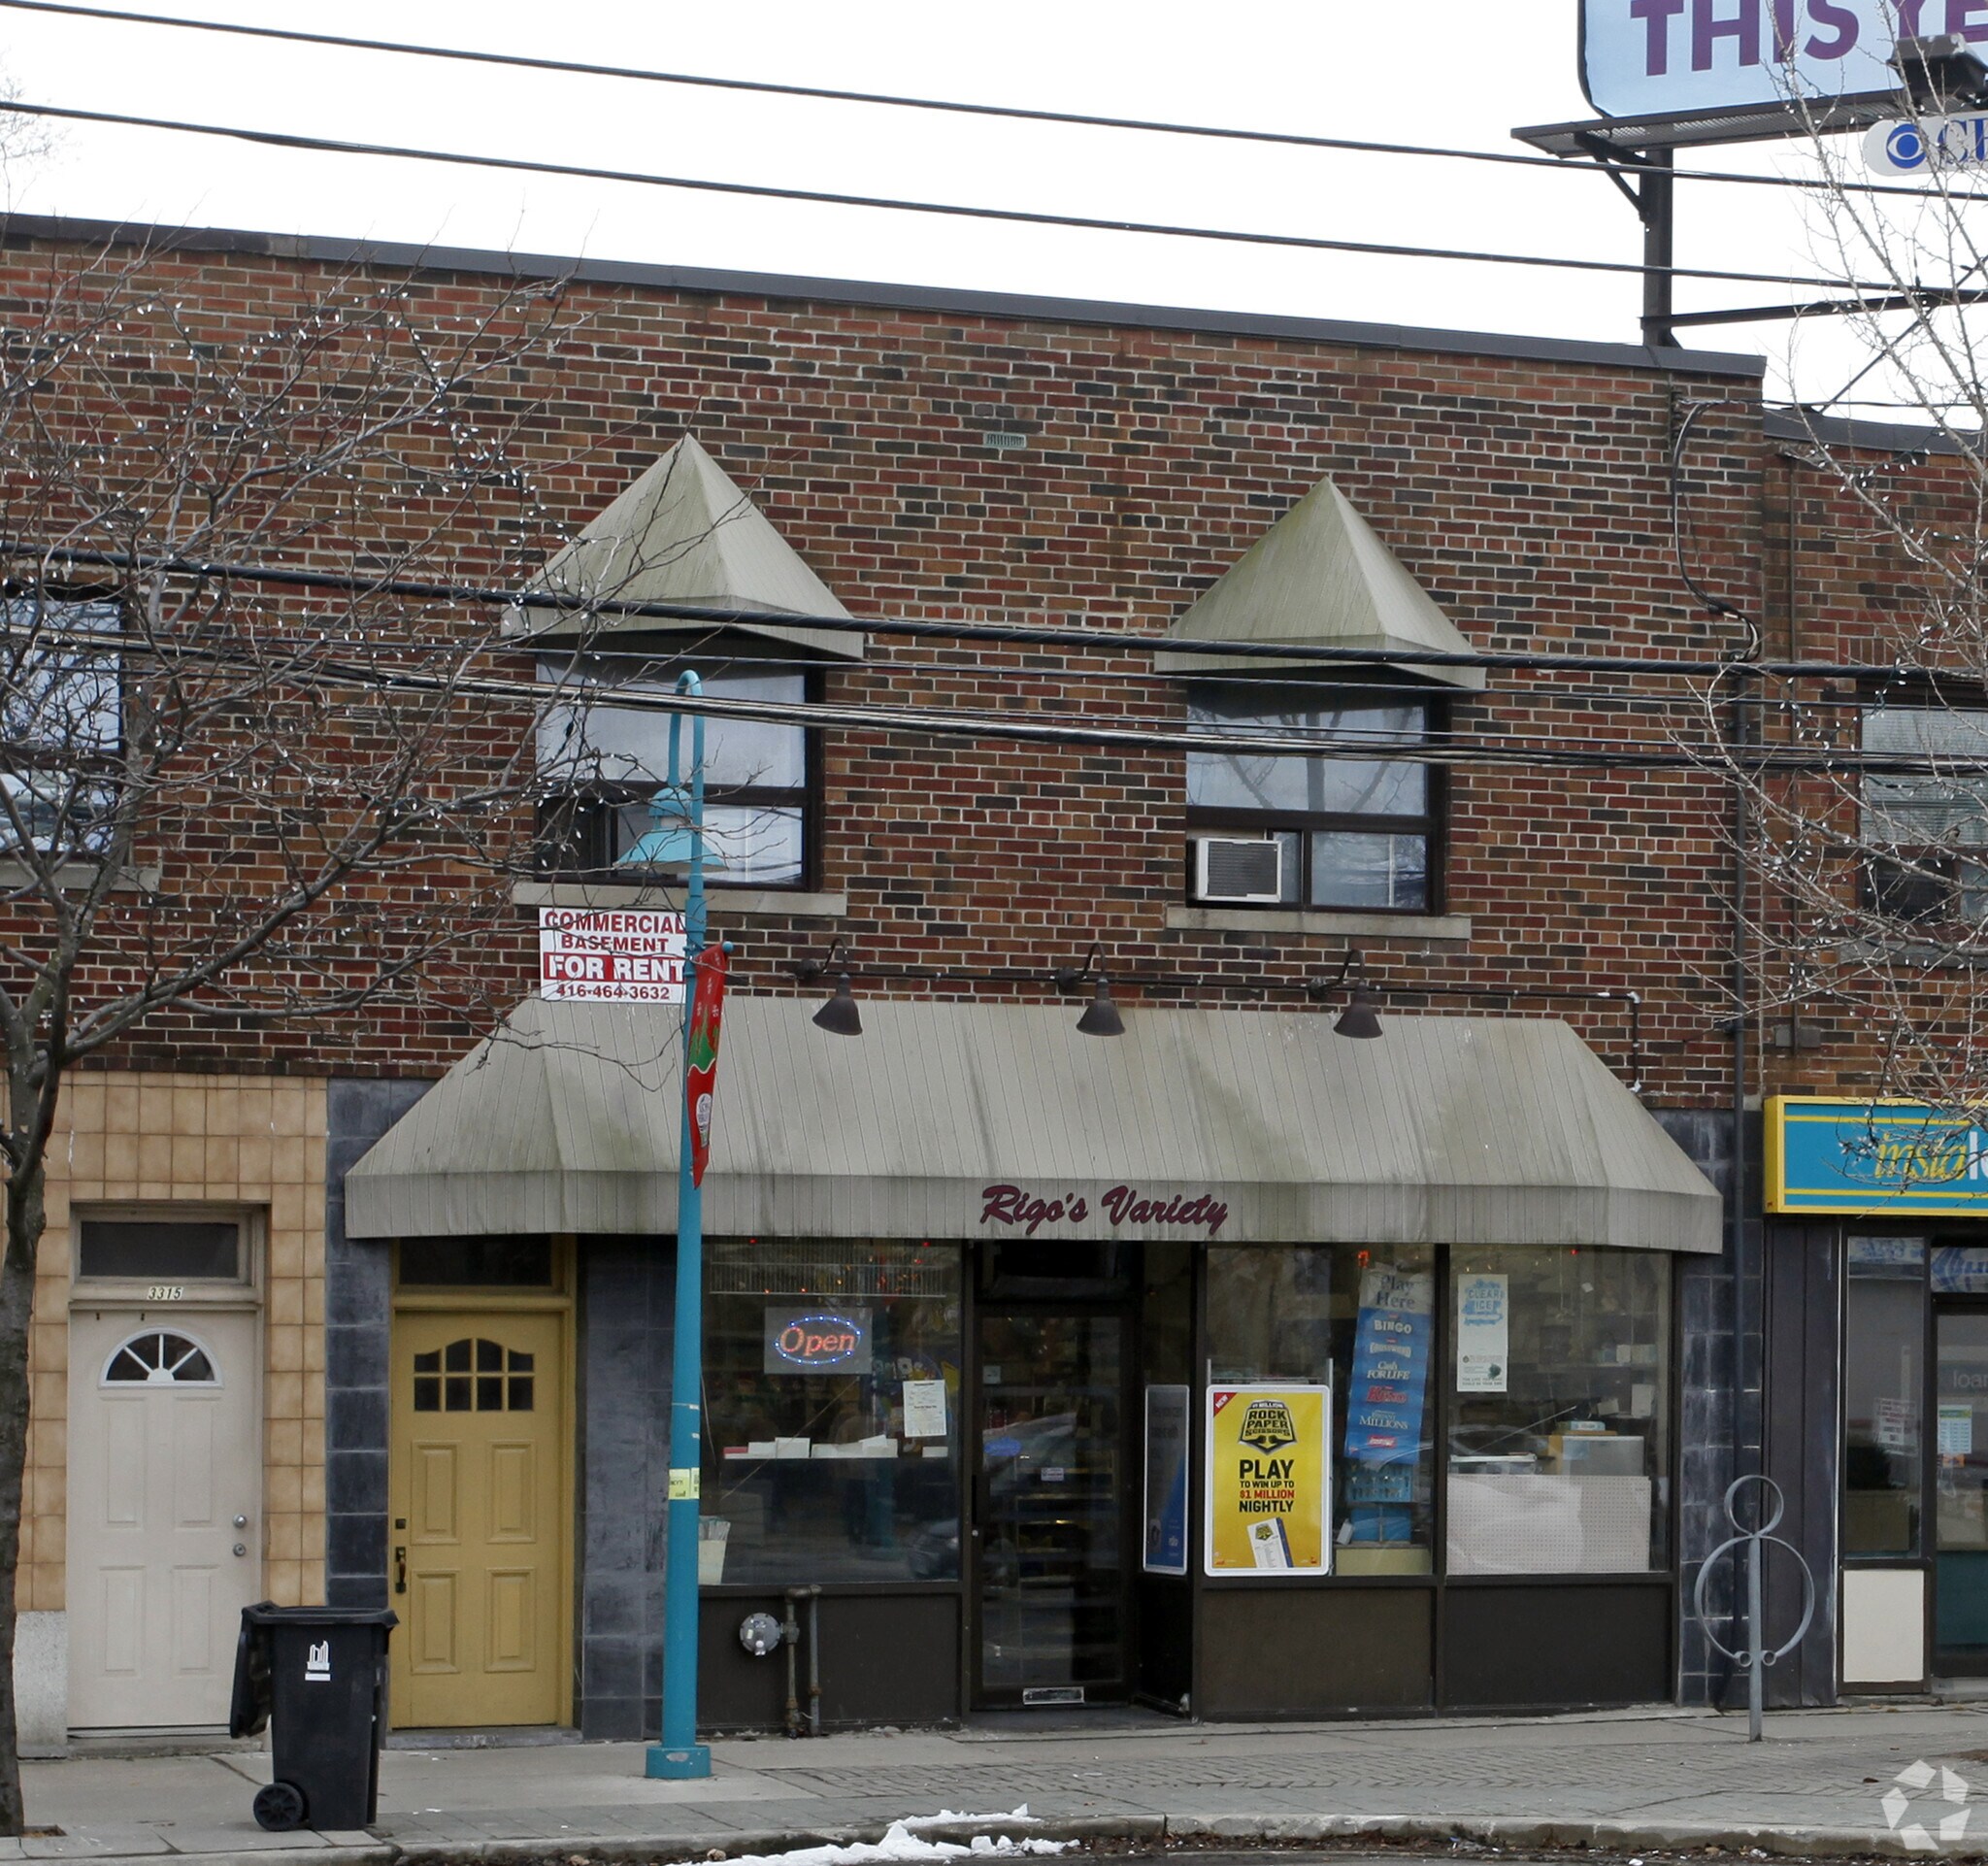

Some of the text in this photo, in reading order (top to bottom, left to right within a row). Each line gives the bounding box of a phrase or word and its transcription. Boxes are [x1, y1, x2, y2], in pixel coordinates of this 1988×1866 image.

[1630, 0, 1860, 77] THIS
[545, 911, 685, 935] COMMERCIAL
[561, 935, 670, 952] BASEMENT
[548, 954, 685, 982] FOR RENT
[556, 983, 670, 1000] 416-464-3632
[979, 1184, 1229, 1236] Rigo's Variety
[148, 1286, 183, 1300] 3315
[1376, 1289, 1415, 1309] Here
[1475, 1299, 1493, 1311] ICE
[1374, 1319, 1412, 1335] BINGO
[779, 1326, 855, 1357] Open
[1248, 1410, 1286, 1419] ROCK
[1359, 1415, 1408, 1430] MILLIONS
[1247, 1419, 1288, 1429] PAPER
[1239, 1459, 1294, 1480] PLAY
[1240, 1489, 1294, 1499] $1 MILLION
[1239, 1500, 1294, 1513] NIGHTLY
